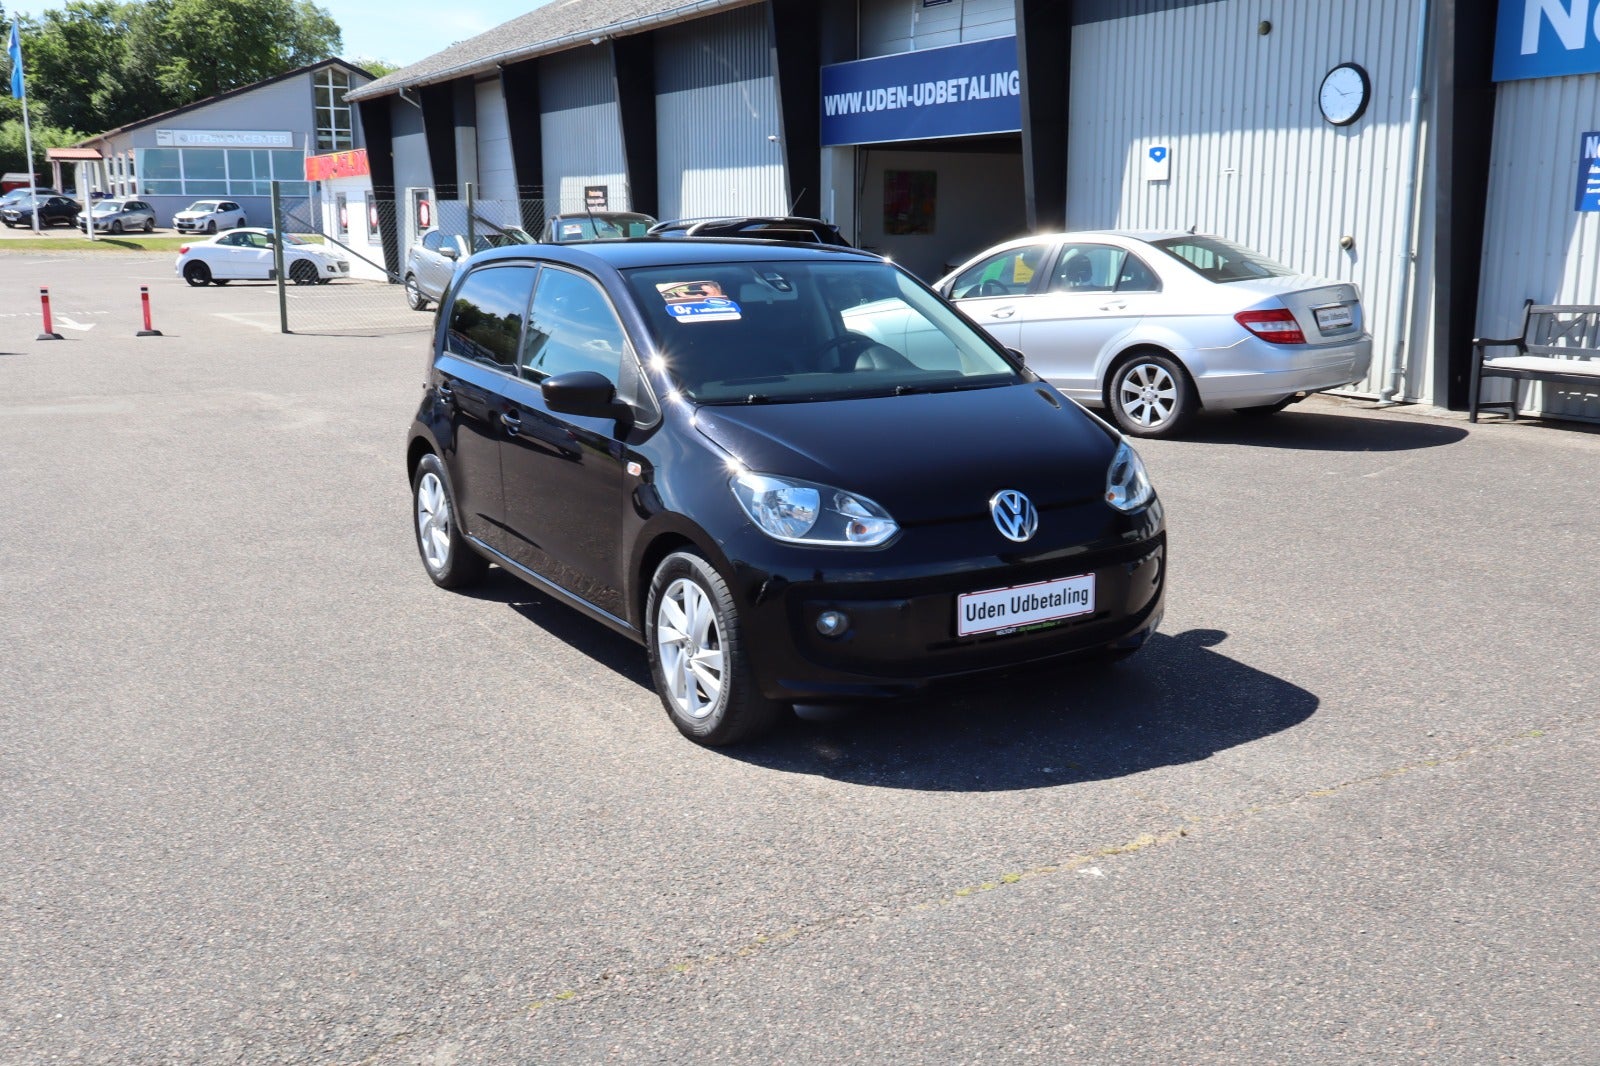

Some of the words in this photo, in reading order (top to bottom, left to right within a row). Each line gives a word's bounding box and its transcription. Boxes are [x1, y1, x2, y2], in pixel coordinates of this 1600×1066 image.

[1521, 0, 1600, 55] N
[824, 70, 1020, 116] WWW.UDEN-UDBETALING
[1584, 136, 1600, 159] N
[966, 602, 1005, 622] Uden
[1011, 587, 1089, 614] Udbetaling
